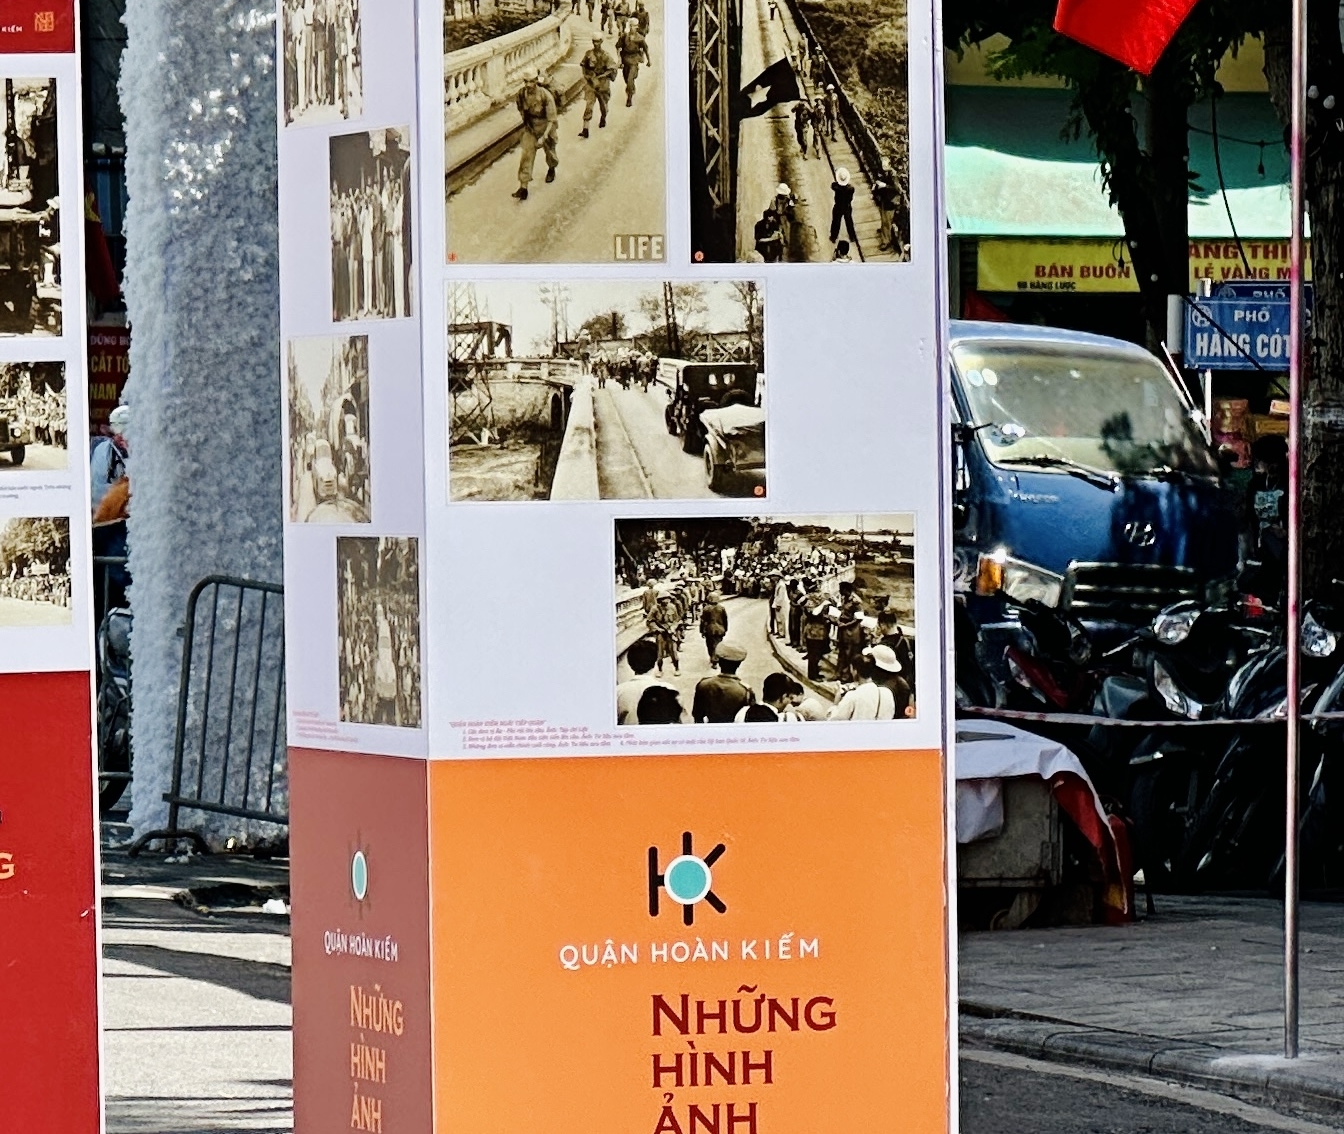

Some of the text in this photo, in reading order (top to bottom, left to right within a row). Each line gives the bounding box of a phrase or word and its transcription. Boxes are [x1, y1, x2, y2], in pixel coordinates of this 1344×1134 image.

[616, 236, 663, 259] LIFE
[1079, 262, 1131, 279] BUÔN
[1233, 306, 1271, 323] PHỐ
[1195, 326, 1251, 357] HÀNG
[324, 928, 399, 962] QUẬN HOÀN KIẾM
[559, 931, 819, 970] QUẬN HOÀN KIẾM
[350, 983, 404, 1037] NHỮNG
[652, 984, 838, 1037] NHỮNG
[350, 1032, 386, 1084] HÌNH
[652, 1041, 774, 1088] HÌNH
[350, 1081, 383, 1134] ẢNH
[653, 1092, 758, 1134] ẢNH
